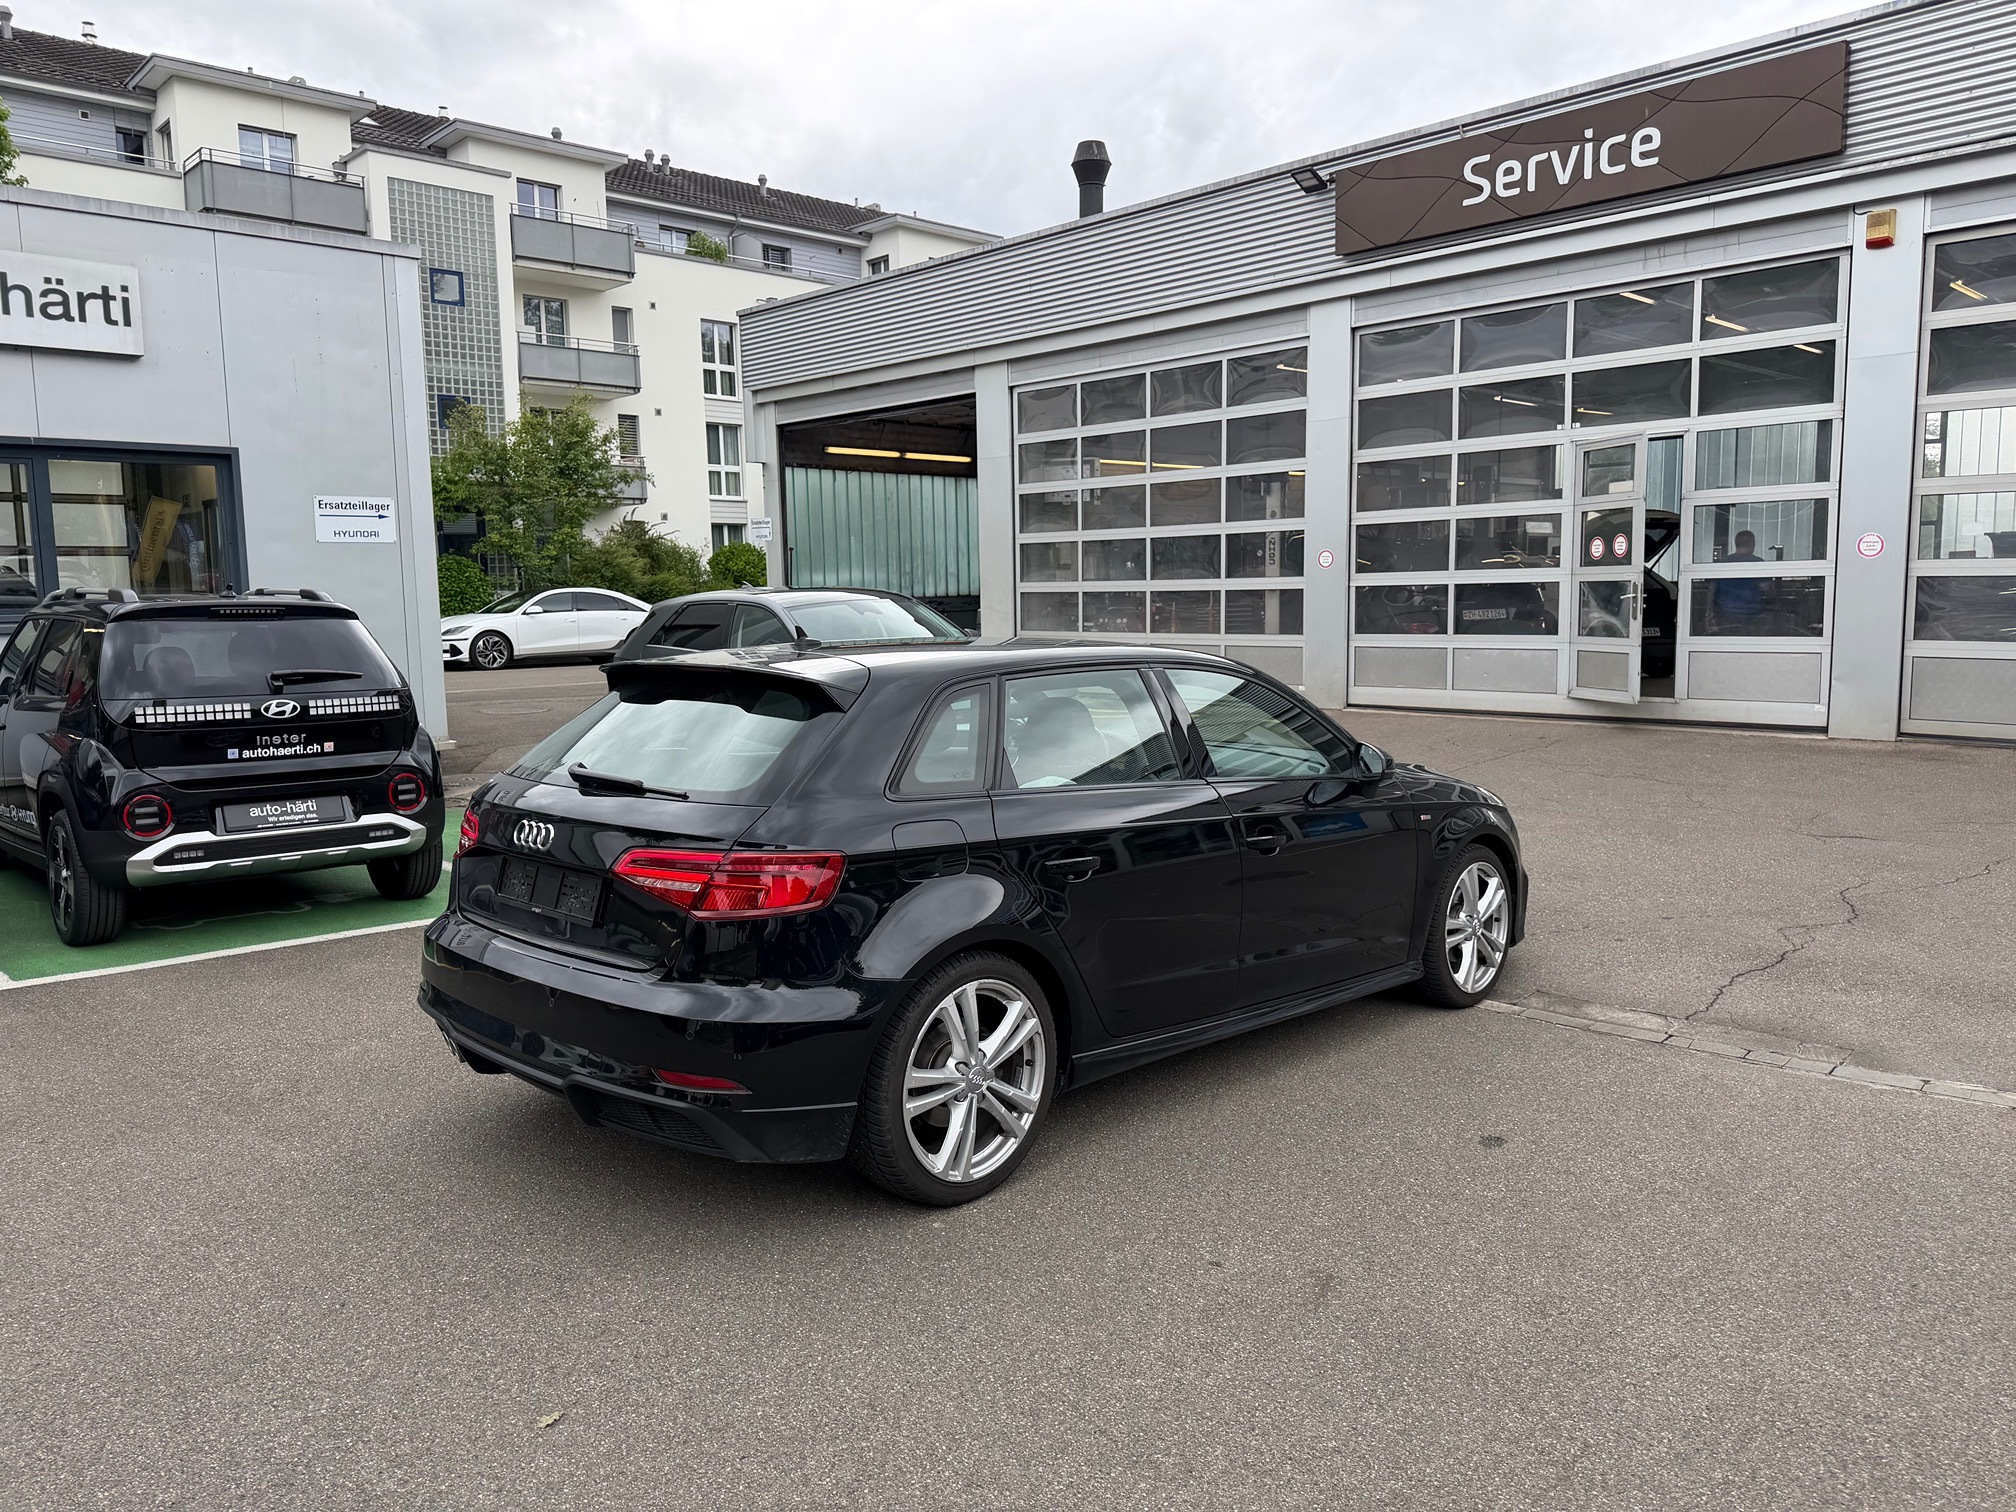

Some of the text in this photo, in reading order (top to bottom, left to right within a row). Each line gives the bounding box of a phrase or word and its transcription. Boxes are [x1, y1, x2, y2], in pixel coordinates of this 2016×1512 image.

[1462, 127, 1661, 206] Service
[318, 500, 390, 513] Ersatzteillager
[333, 530, 380, 538] HYUNDAI
[242, 743, 322, 758] autohaerti.ch
[249, 799, 317, 817] auto-härti
